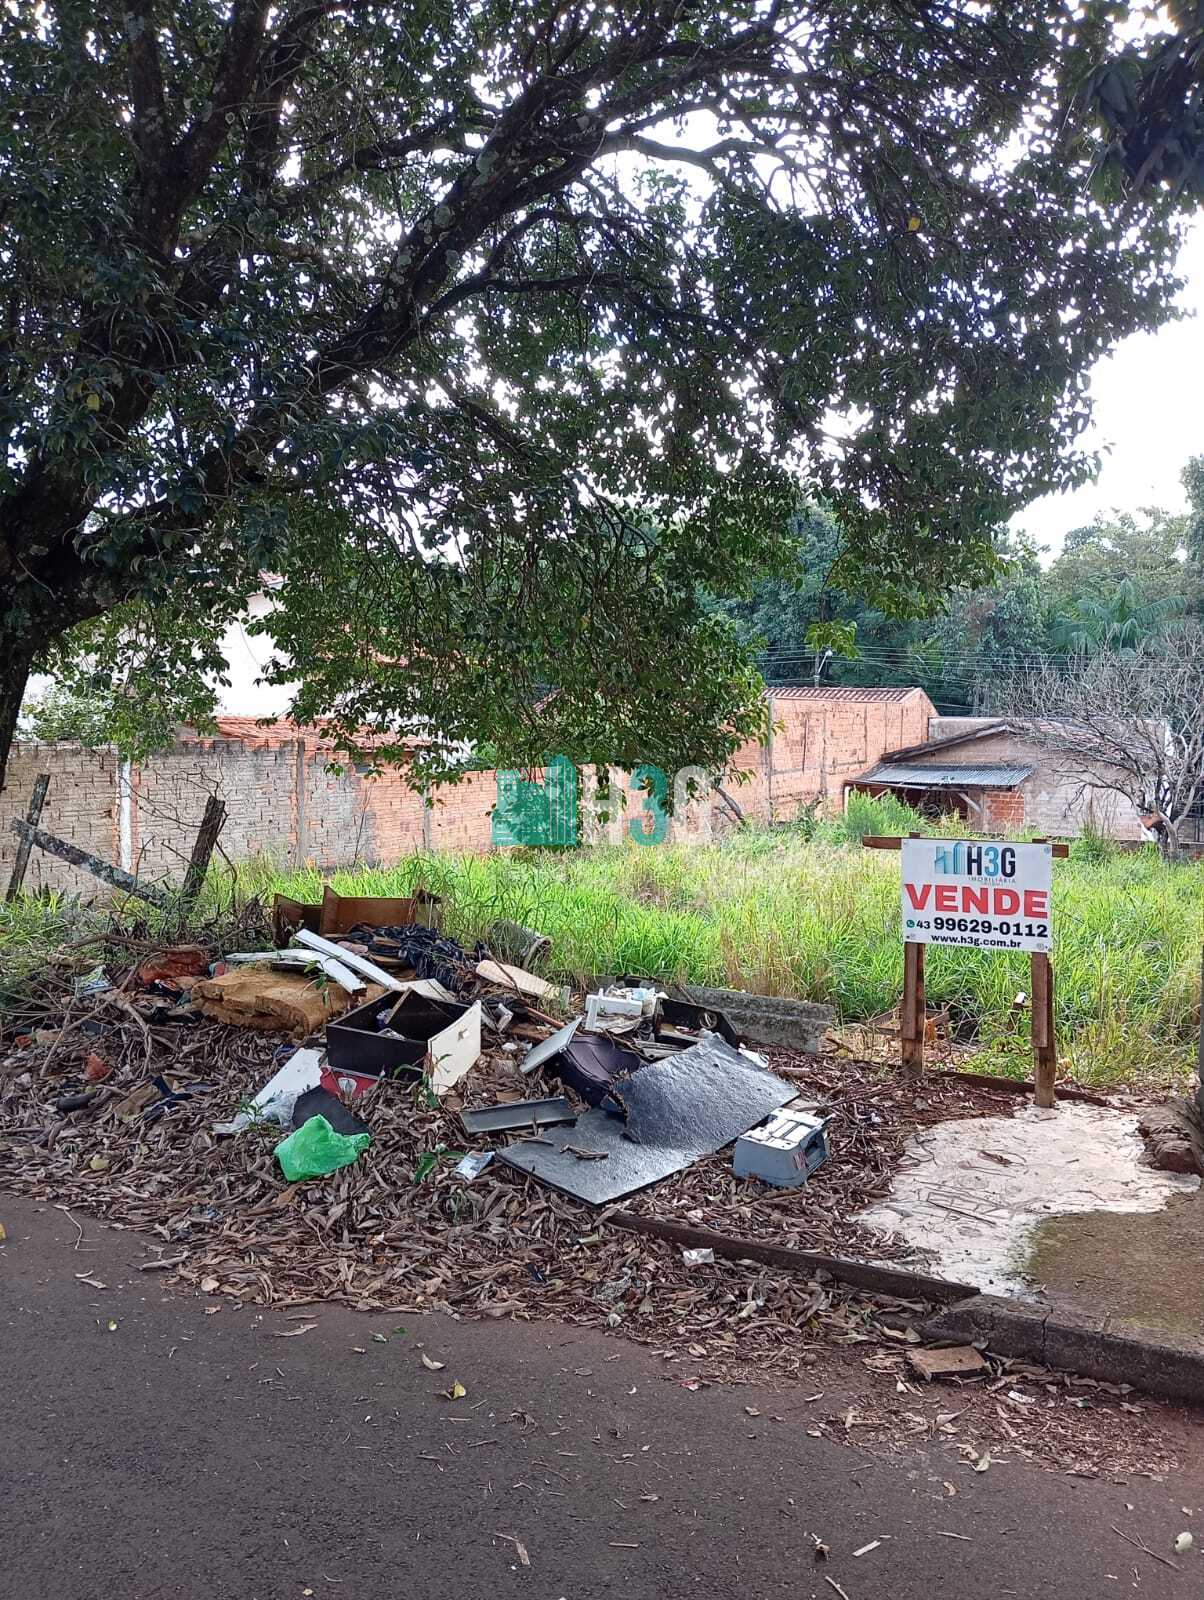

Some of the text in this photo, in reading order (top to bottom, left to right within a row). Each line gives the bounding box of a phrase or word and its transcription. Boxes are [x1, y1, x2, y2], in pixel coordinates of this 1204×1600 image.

[967, 846, 1016, 877] H3G
[904, 883, 1048, 919] VENDE
[916, 917, 1048, 938] 43 99629-0112
[931, 934, 1021, 948] www.h3g.com.br
